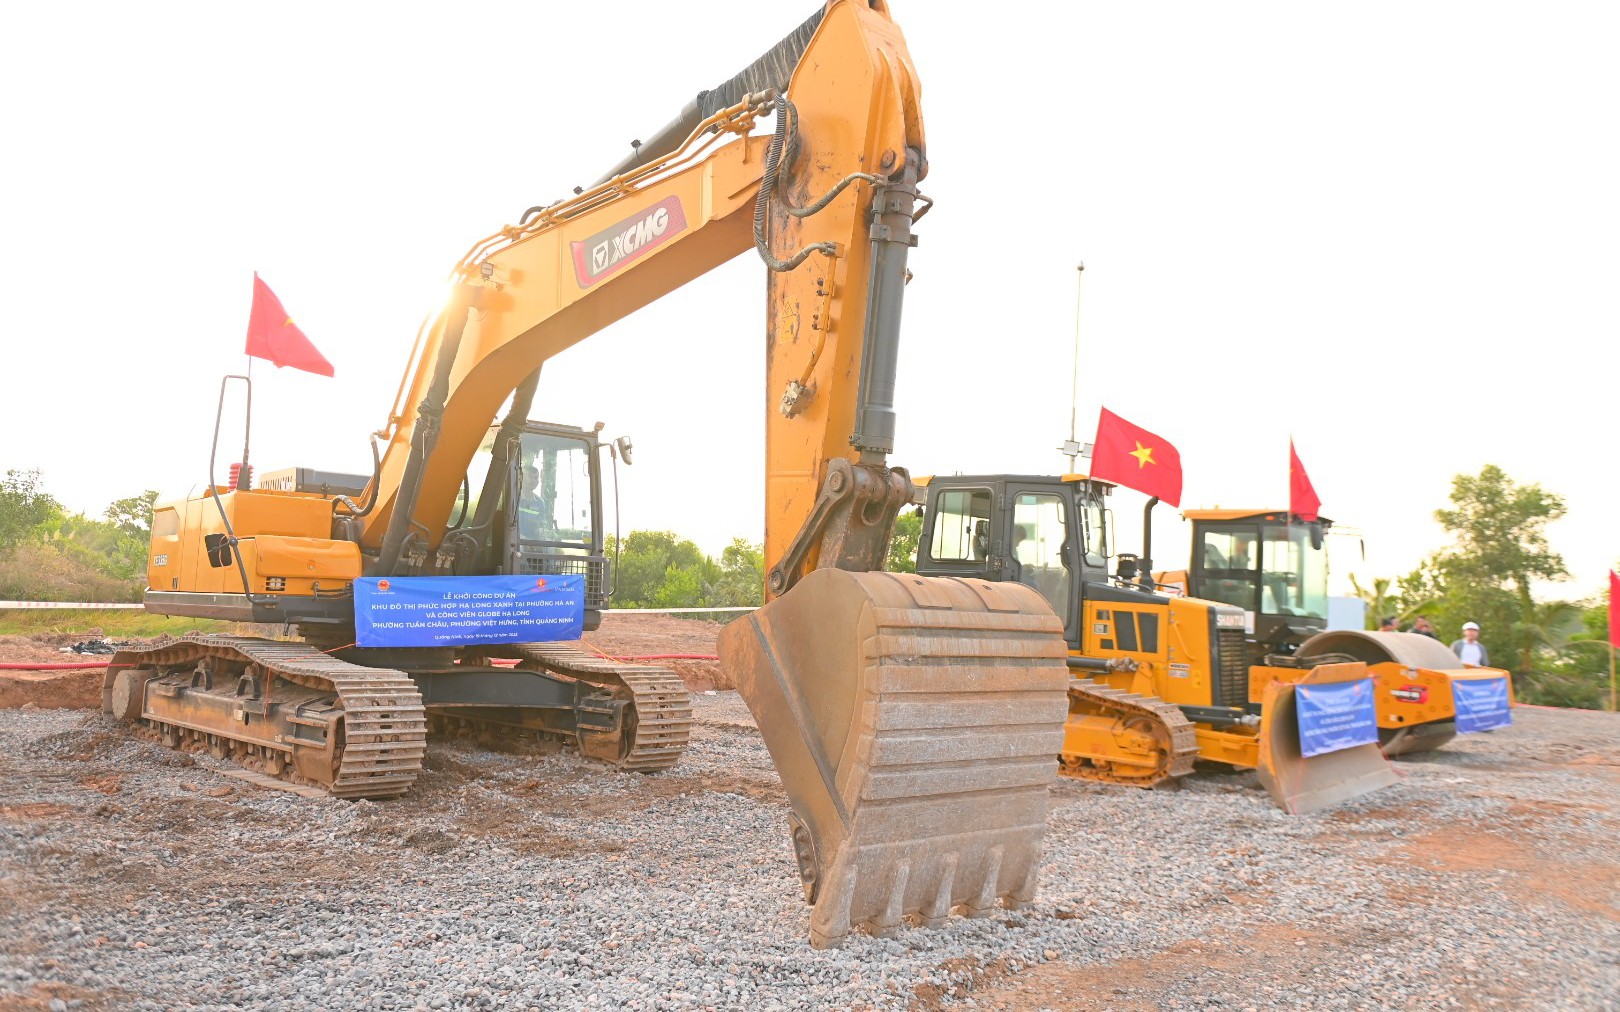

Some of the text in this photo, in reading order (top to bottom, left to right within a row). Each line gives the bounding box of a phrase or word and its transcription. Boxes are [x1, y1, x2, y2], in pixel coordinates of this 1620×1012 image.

[610, 207, 669, 265] XCMG
[443, 592, 452, 600] LỄ
[453, 592, 471, 600] KHỞI
[389, 602, 402, 610] ĐÔ
[403, 603, 416, 611] THỊ
[459, 602, 470, 610] HẠ
[514, 601, 525, 609] TẠI
[426, 611, 436, 619] VÀ
[502, 610, 512, 618] HẠ
[372, 621, 404, 629] PHƯỜNG
[427, 620, 449, 629] CHÂU,
[450, 619, 482, 627] PHƯỜNG
[482, 619, 497, 627] VIỆT
[535, 617, 558, 625] QUẢNG
